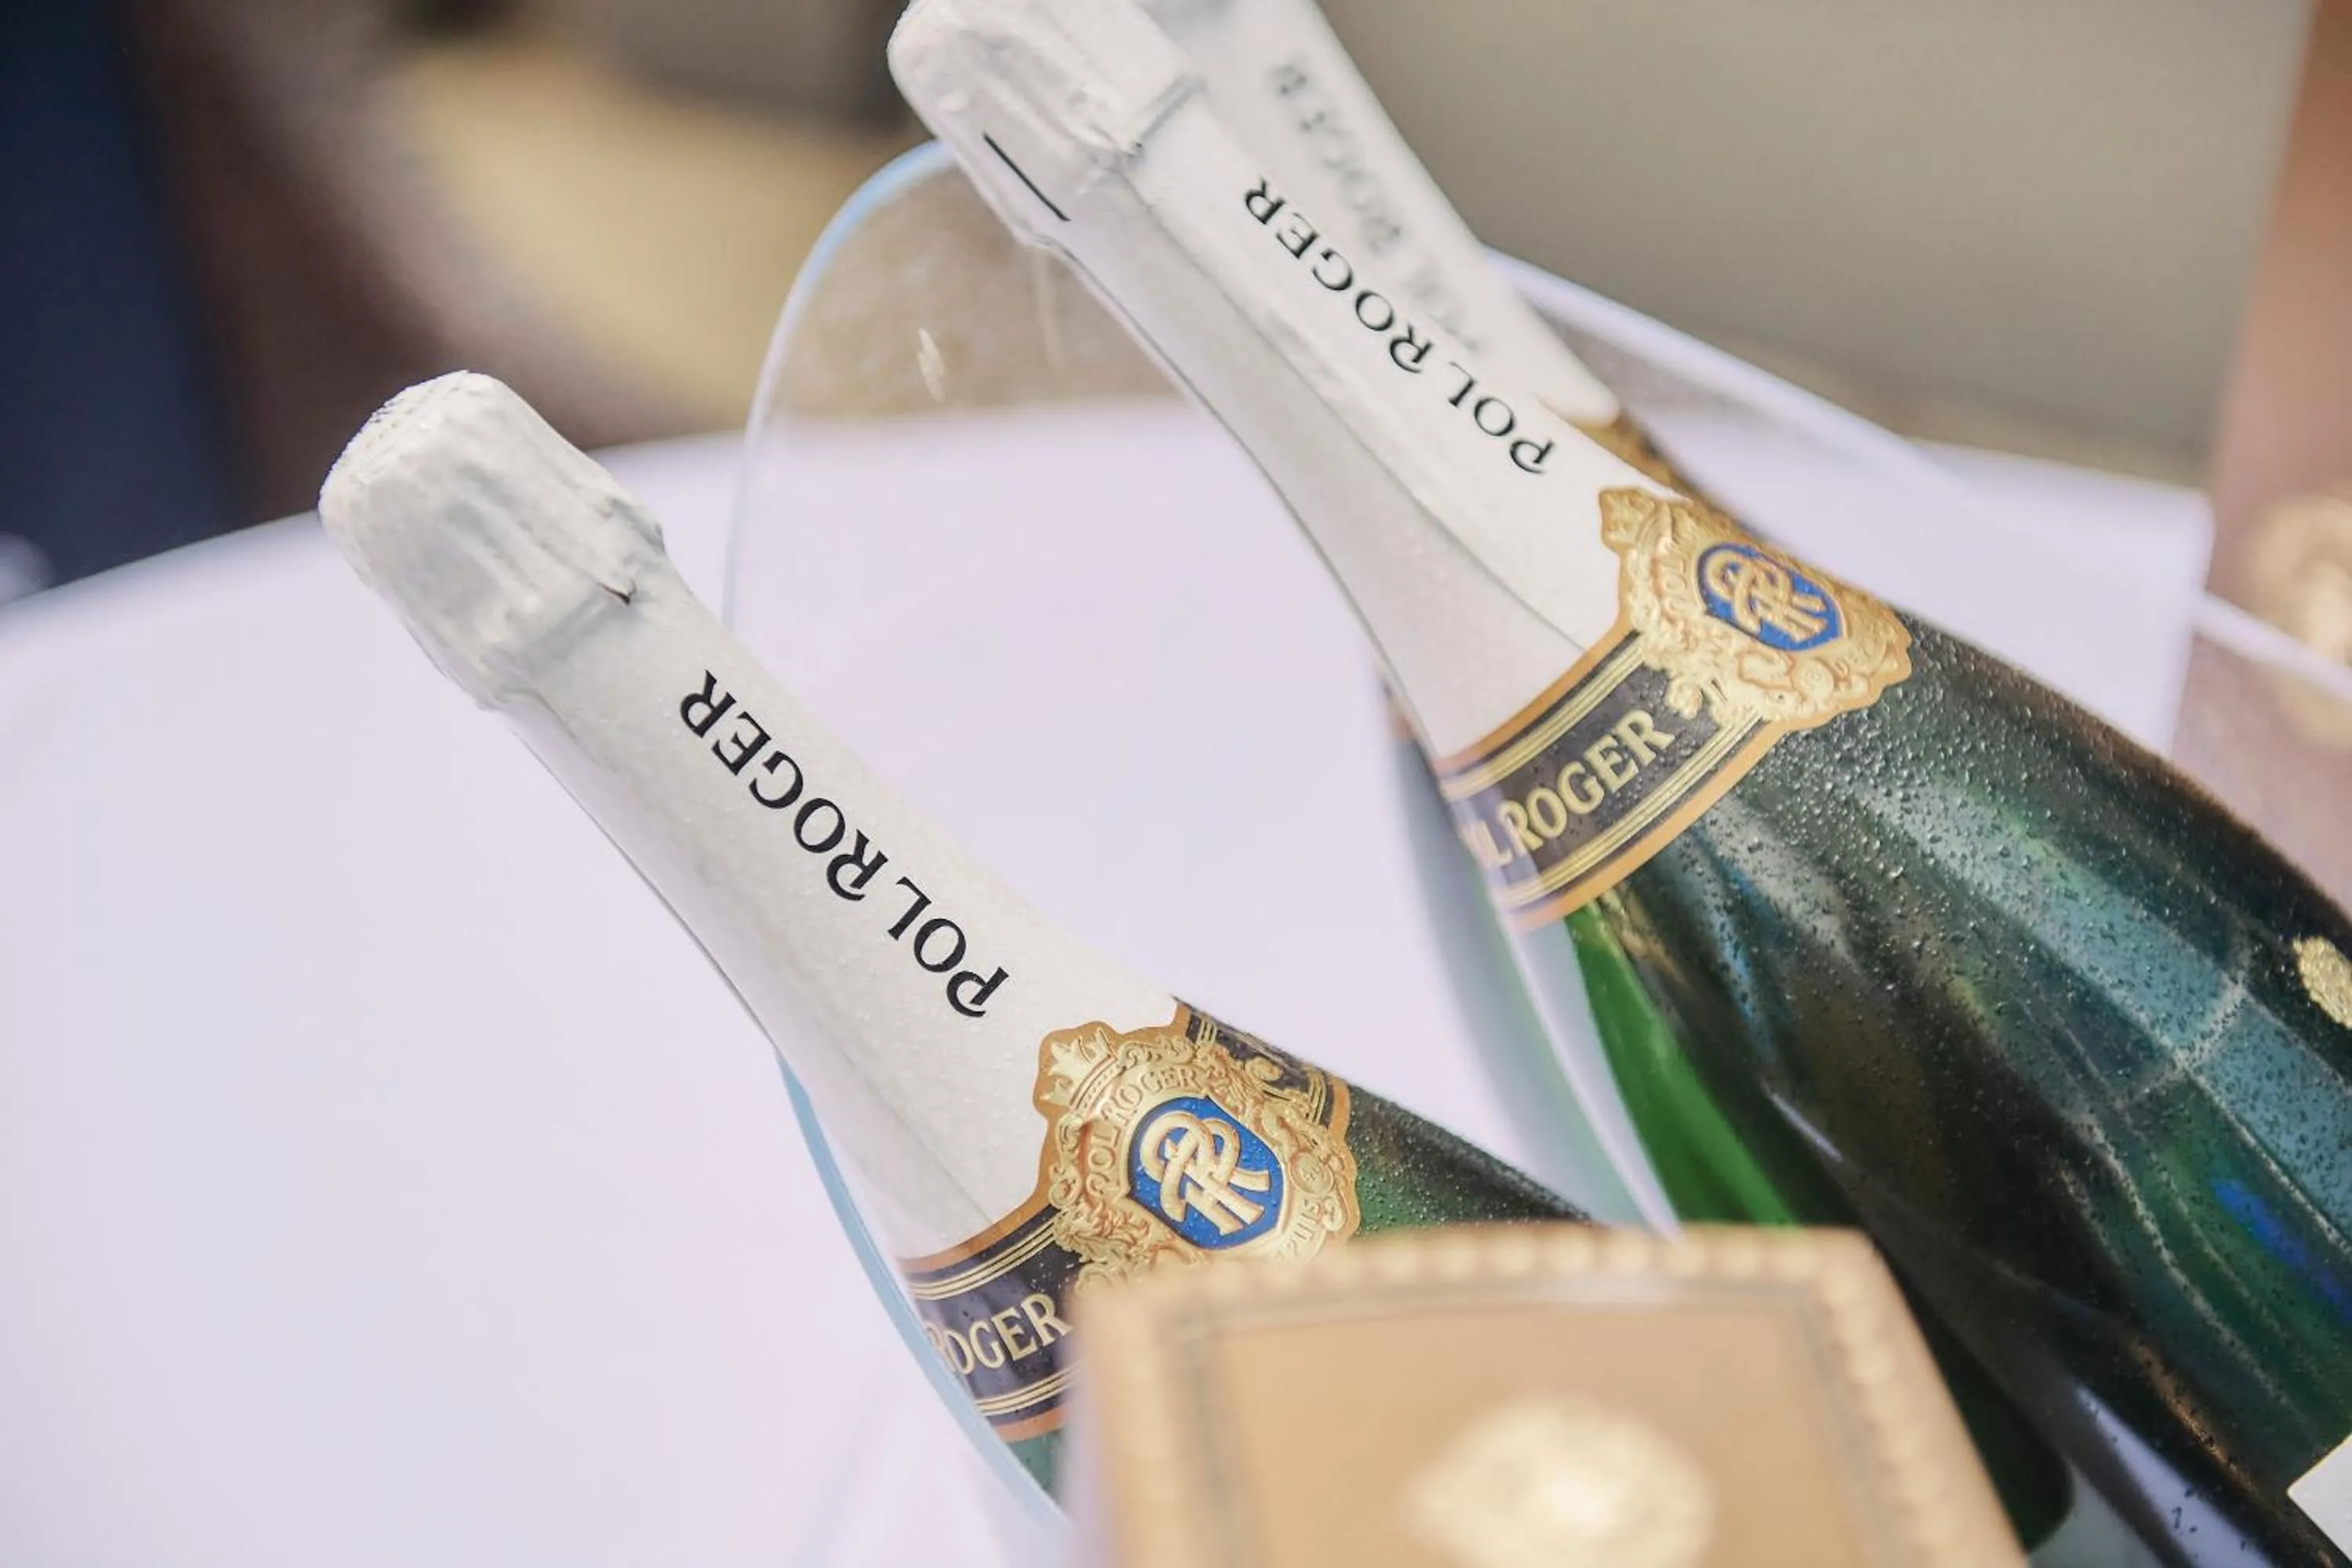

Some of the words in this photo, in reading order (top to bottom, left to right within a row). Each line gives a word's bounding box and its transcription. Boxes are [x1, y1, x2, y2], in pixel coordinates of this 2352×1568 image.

[1244, 174, 1434, 374] ROGER
[1448, 360, 1555, 475] POL
[679, 670, 889, 902] ROGER
[1495, 709, 1675, 857] ROGER
[887, 876, 1010, 1018] POL
[1101, 1065, 1205, 1127] ROGER
